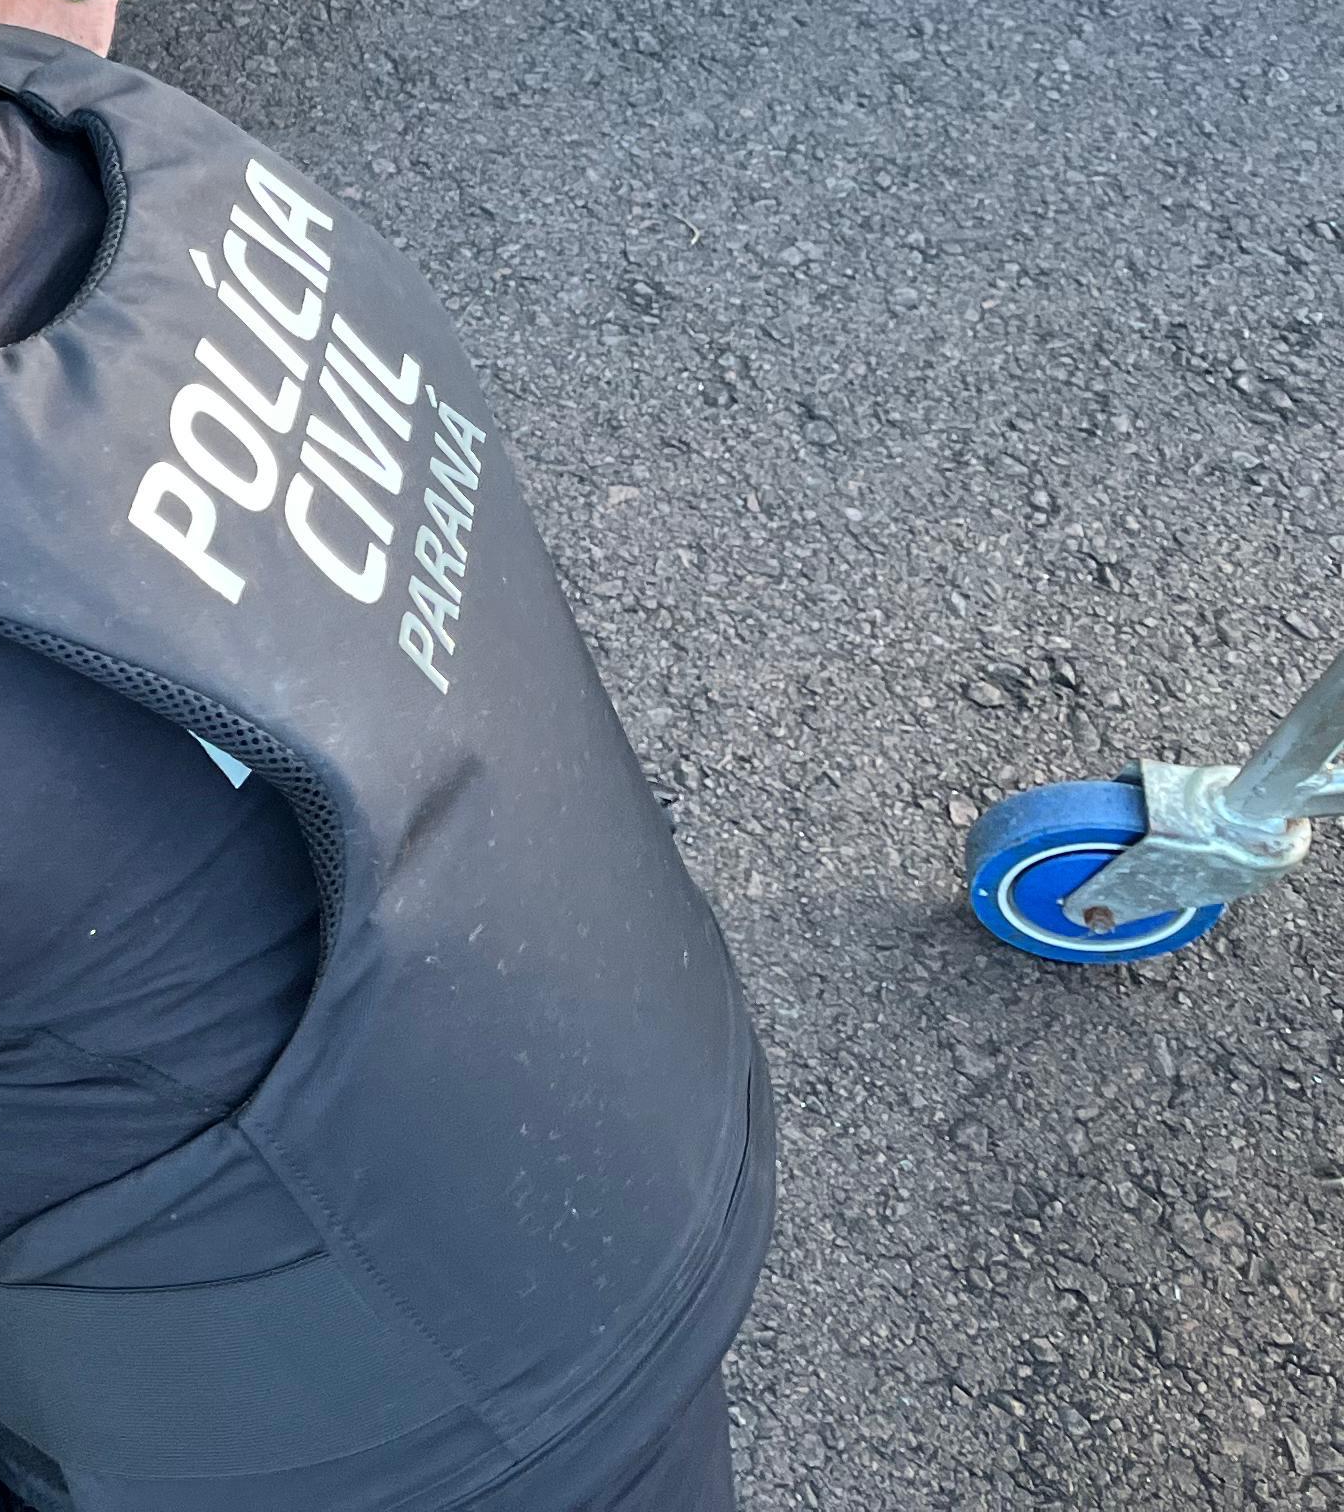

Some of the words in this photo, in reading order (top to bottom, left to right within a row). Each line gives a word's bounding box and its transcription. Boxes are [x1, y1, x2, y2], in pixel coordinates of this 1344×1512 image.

[127, 157, 334, 606] POLÍCIA
[284, 312, 422, 605] CIVIL
[398, 383, 488, 695] PARANÁ
